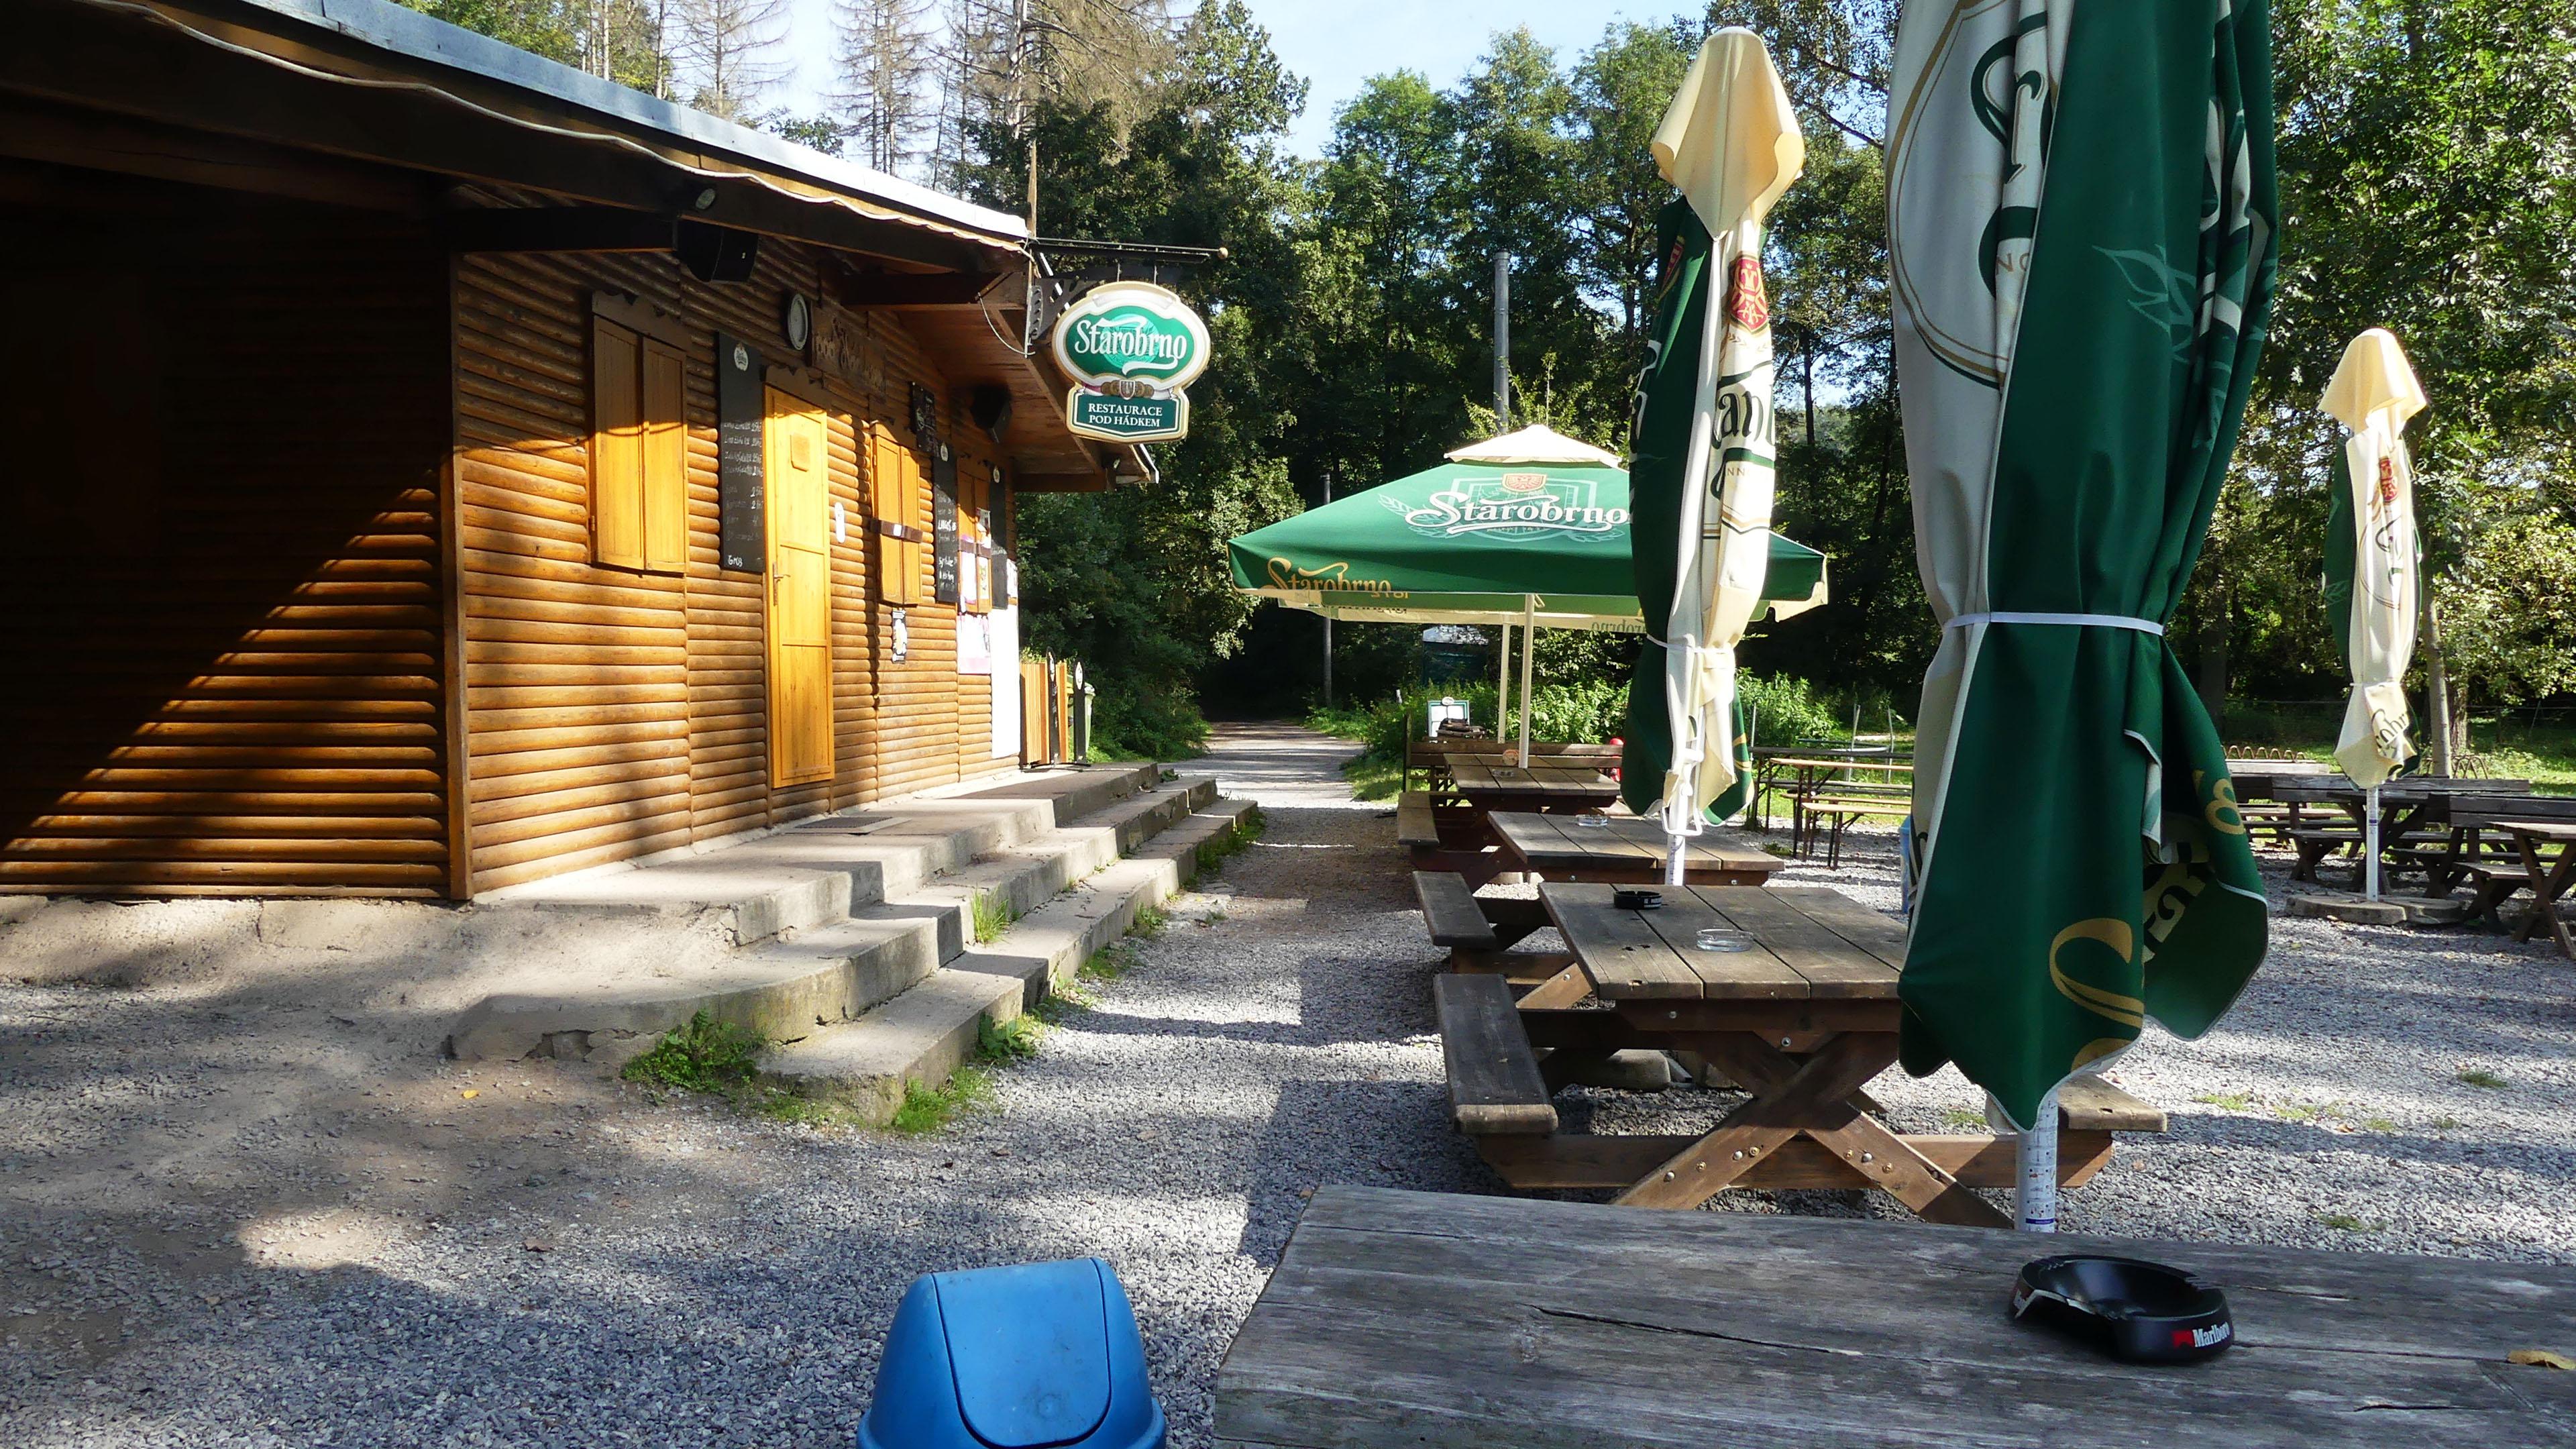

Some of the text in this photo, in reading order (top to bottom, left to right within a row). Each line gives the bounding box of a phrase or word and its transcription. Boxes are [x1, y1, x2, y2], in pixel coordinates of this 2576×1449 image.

[1075, 316, 1187, 376] Starobrno
[1088, 403, 1163, 416] RESTAURACE
[1089, 415, 1160, 427] POD HÁDKEM
[1404, 491, 1629, 535] Starobrno
[2192, 1321, 2231, 1348] Marlboro
